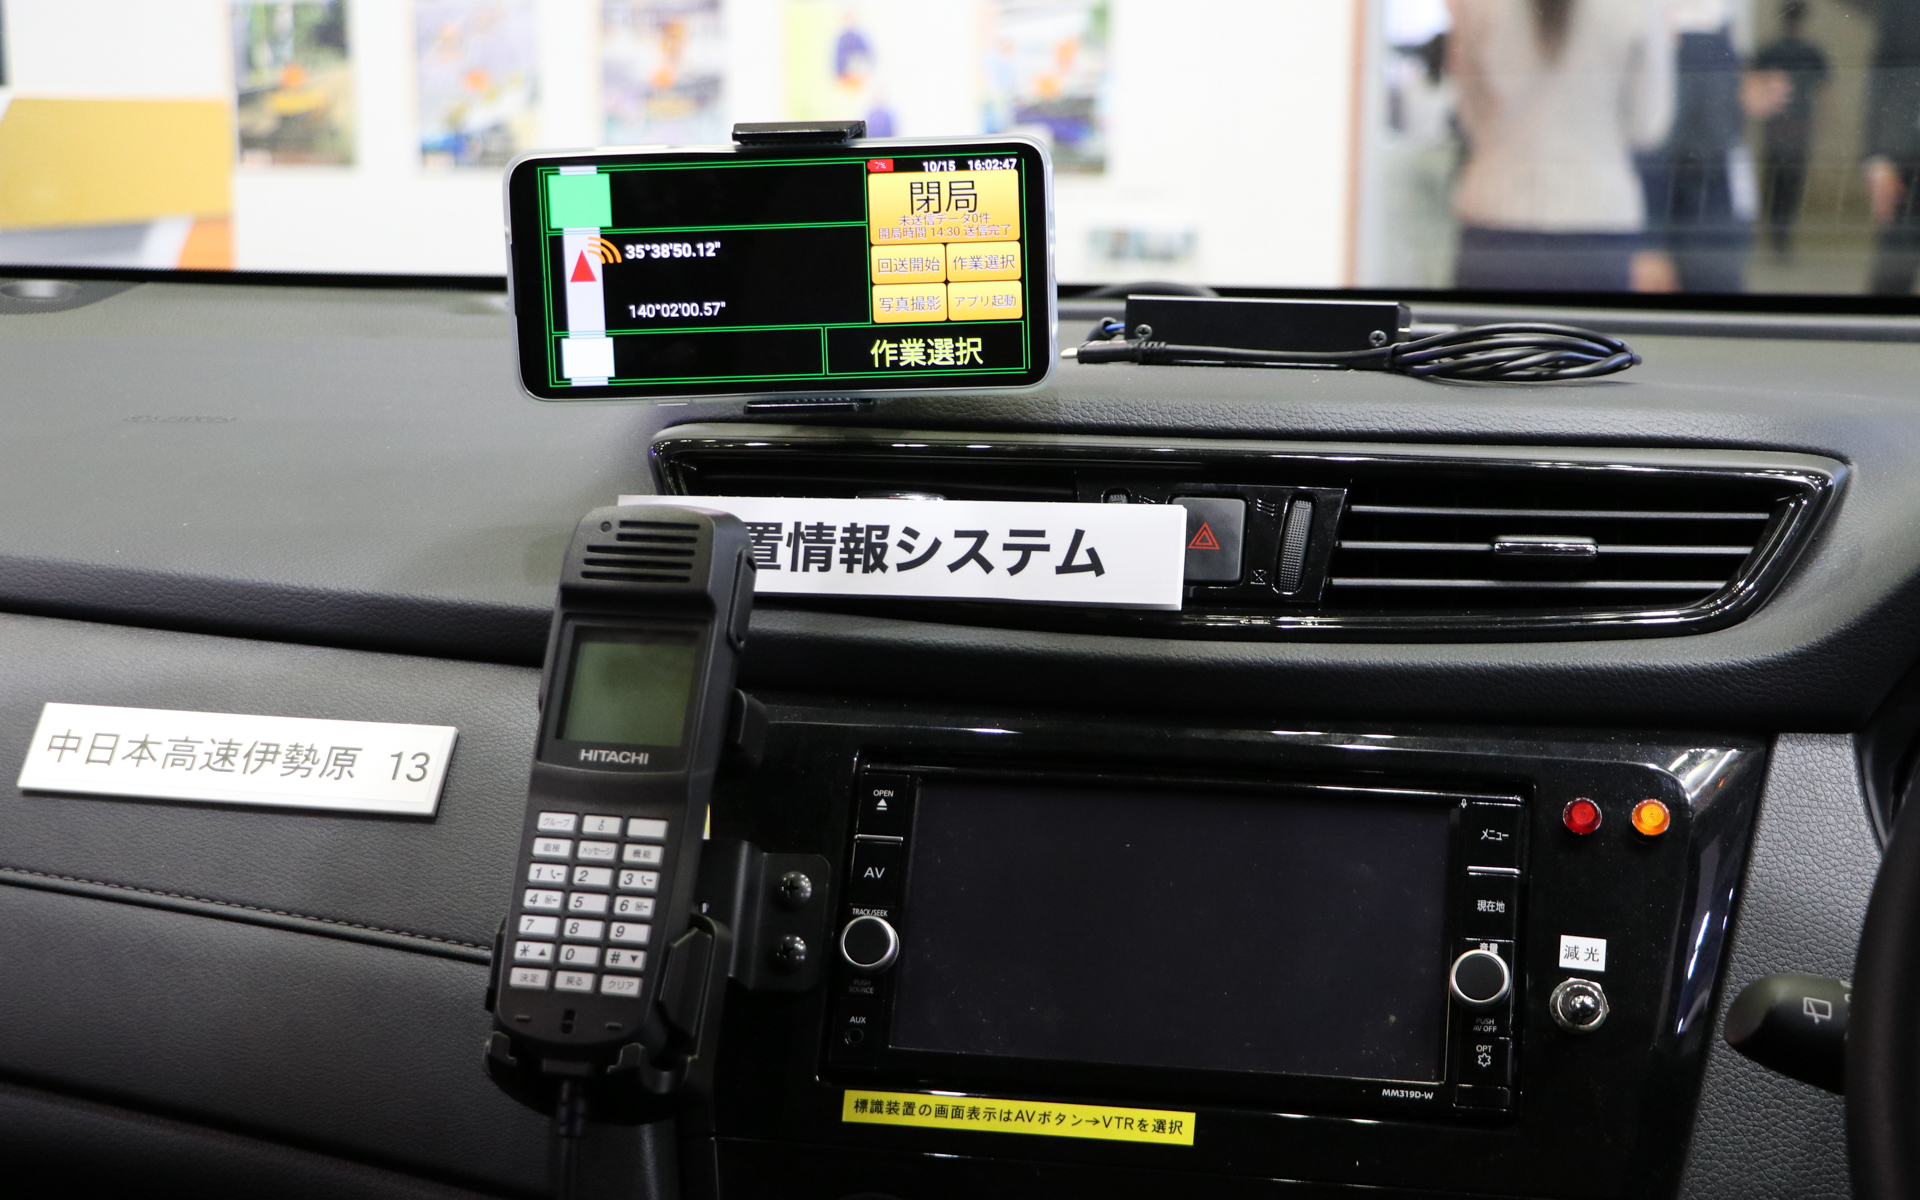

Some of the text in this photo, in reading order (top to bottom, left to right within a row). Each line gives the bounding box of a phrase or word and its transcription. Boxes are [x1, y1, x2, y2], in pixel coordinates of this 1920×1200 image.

[922, 158, 1018, 172] 10/15 16:02:47
[910, 180, 978, 214] 閉局
[899, 212, 991, 227] 未送信データ0件
[878, 224, 1011, 241] 開局時間 14:30 送信完了
[878, 256, 940, 274] 回送開始
[953, 254, 1016, 271] 作業選択
[879, 295, 942, 313] 写真撮影
[954, 294, 1016, 309] アプリ起動
[870, 336, 984, 368] 作業選択
[46, 728, 431, 783] 中日本高速伊勢原 13
[579, 748, 649, 765] HITACHI
[873, 789, 894, 797] OPEN
[542, 817, 571, 828] グループ
[1480, 828, 1509, 841] メニュー
[543, 843, 560, 853] 直接
[581, 846, 613, 856] メッセージ
[632, 849, 652, 859] 機能
[535, 867, 543, 879] 1
[577, 870, 588, 882] 2
[623, 873, 634, 885] 3
[863, 867, 886, 879] AV
[529, 893, 538, 905] 4
[573, 896, 584, 908] 5
[619, 899, 630, 912] 6
[1477, 900, 1505, 913] 現在地
[852, 907, 888, 917] TRACK/SEEK
[525, 919, 535, 930] 7
[569, 922, 580, 934] 8
[615, 925, 625, 937] 9
[565, 948, 576, 961] 0
[1563, 944, 1600, 962] 減光
[519, 973, 539, 983] 決定
[565, 976, 583, 986] 戻る
[608, 979, 634, 990] クリア
[849, 986, 874, 994] SOURCE
[849, 1016, 866, 1024] AUX
[1382, 1088, 1434, 1100] MM319D-W
